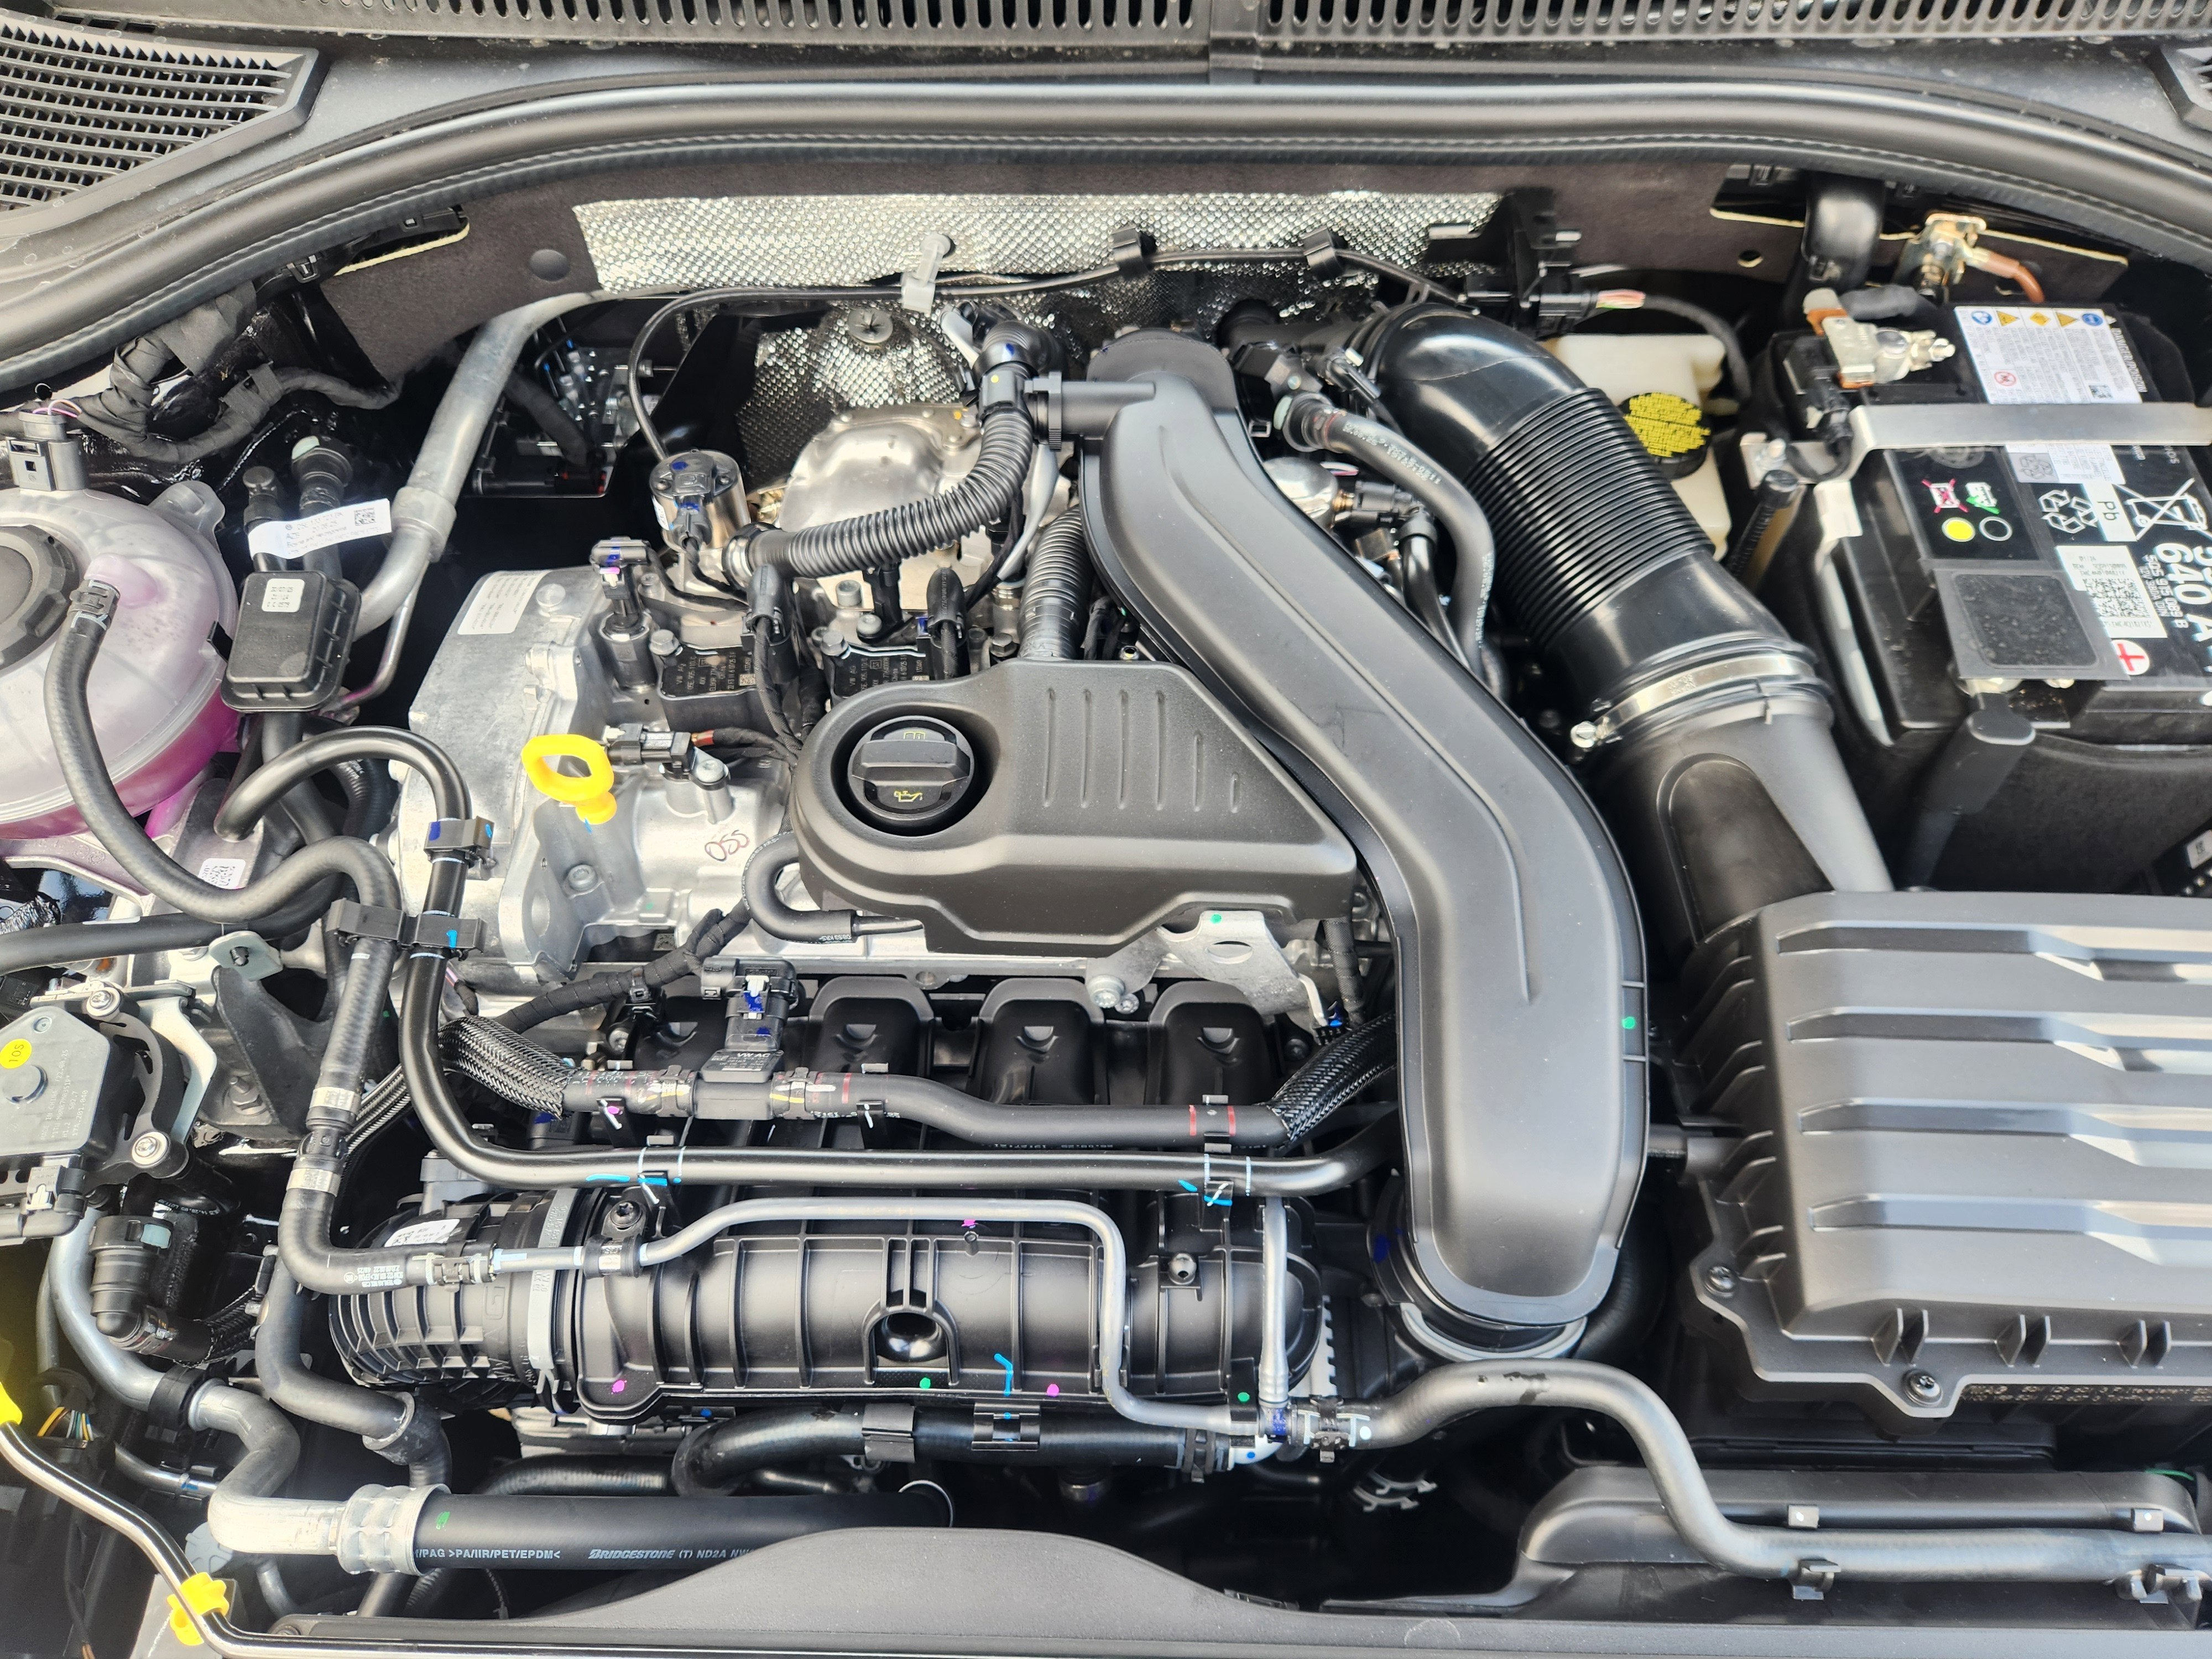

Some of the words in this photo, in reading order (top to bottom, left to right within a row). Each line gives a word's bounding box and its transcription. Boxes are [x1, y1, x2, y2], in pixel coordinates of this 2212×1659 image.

[2098, 501, 2121, 521] Pb
[2155, 542, 2212, 605] 640
[2157, 578, 2174, 597] 915
[448, 1549, 560, 1559] >PA/IIR/PET/EPDM<
[588, 1549, 676, 1559] BRIDGESTONE
[679, 1550, 693, 1558] (T)
[697, 1550, 726, 1558] ND2A
